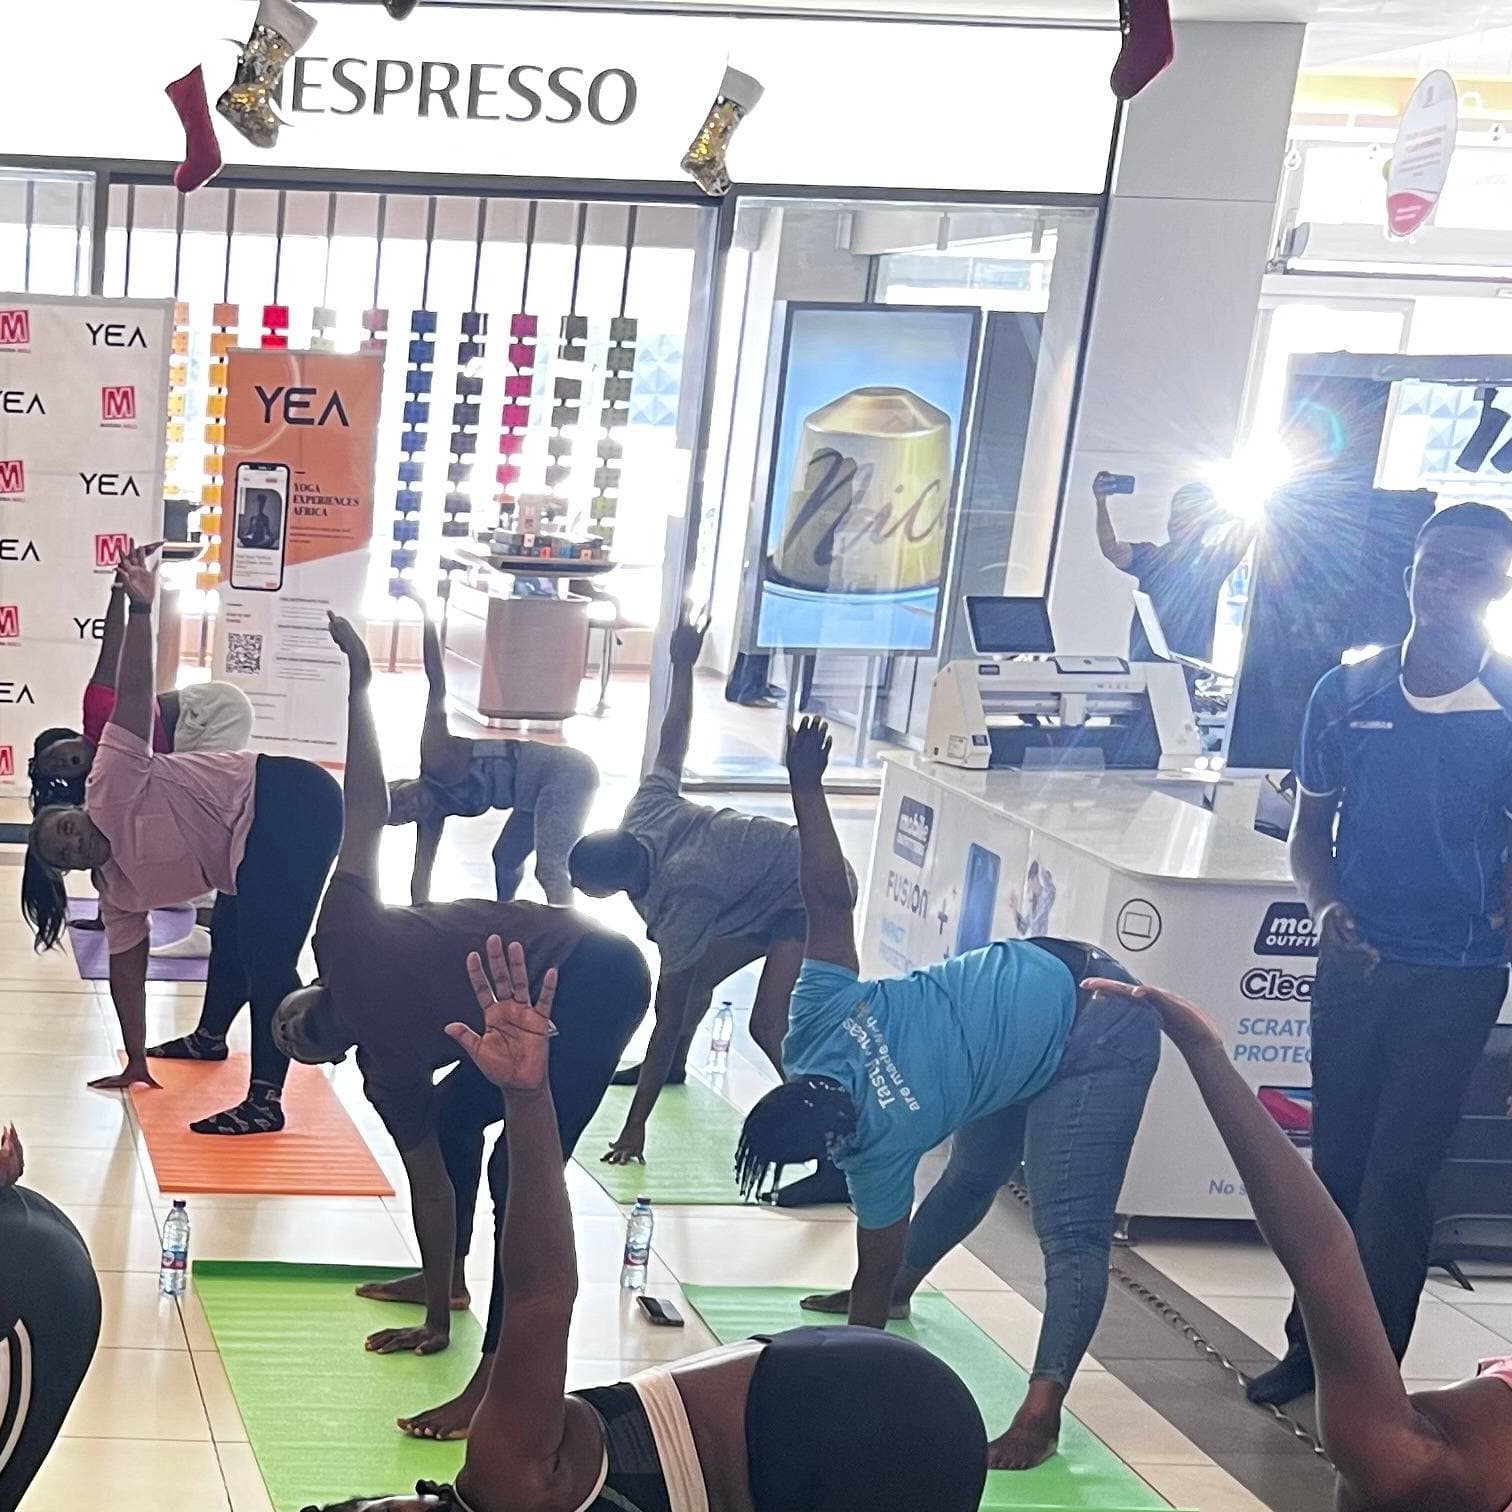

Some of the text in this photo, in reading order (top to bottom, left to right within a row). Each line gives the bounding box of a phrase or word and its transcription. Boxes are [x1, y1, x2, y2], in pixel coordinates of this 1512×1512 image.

[85, 323, 147, 348] YEA
[255, 385, 350, 427] YEA
[79, 472, 140, 497] YEA
[293, 483, 321, 493] YOGA
[293, 495, 360, 507] EXPERIENCES
[293, 507, 329, 517] AFRICA
[74, 617, 105, 640] YE
[1265, 933, 1319, 948] OUTFIT
[1240, 967, 1312, 1002] Clea
[899, 1086, 921, 1111] are
[1209, 1179, 1234, 1195] No
